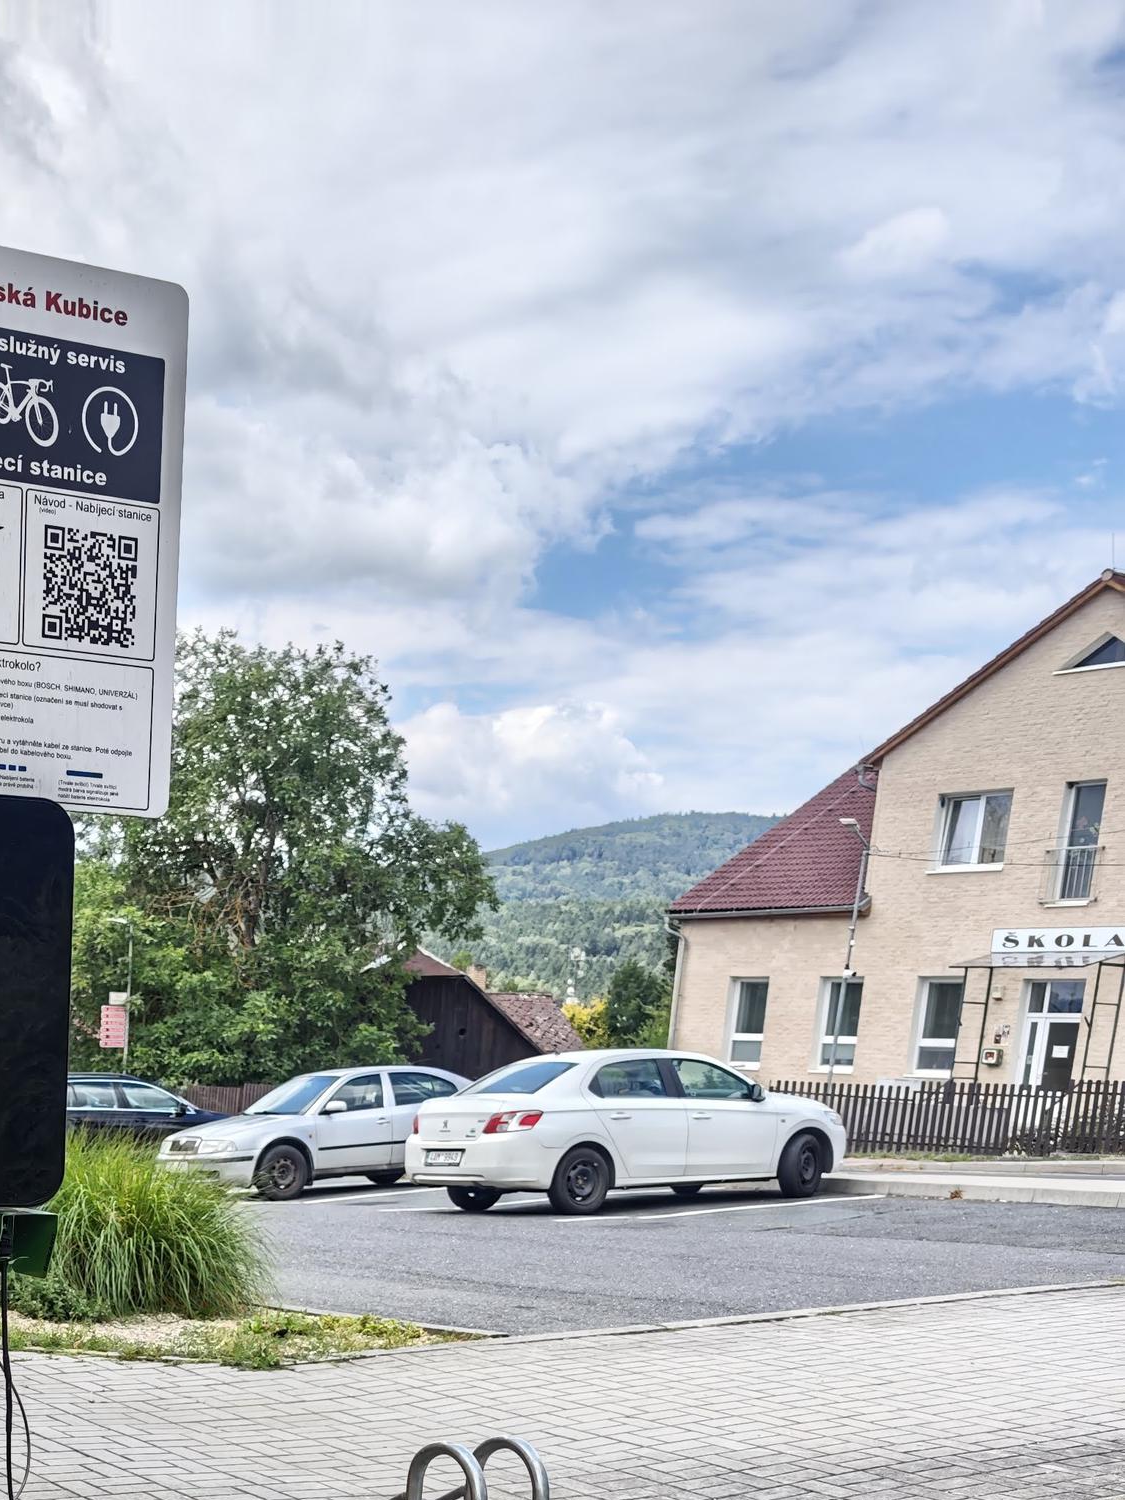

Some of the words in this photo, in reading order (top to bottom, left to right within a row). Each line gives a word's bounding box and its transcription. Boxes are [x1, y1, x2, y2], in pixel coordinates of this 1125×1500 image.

[45, 290, 128, 327] Kubice
[66, 351, 126, 374] servis
[29, 459, 107, 486] stanice
[34, 494, 66, 509] Návod
[75, 500, 116, 516] Nabíjecí
[118, 509, 152, 522] stanice
[39, 506, 57, 515] (video)
[20, 749, 55, 759] kabelového
[56, 752, 73, 761] boxu.
[1001, 931, 1125, 949] ŠKOLA
